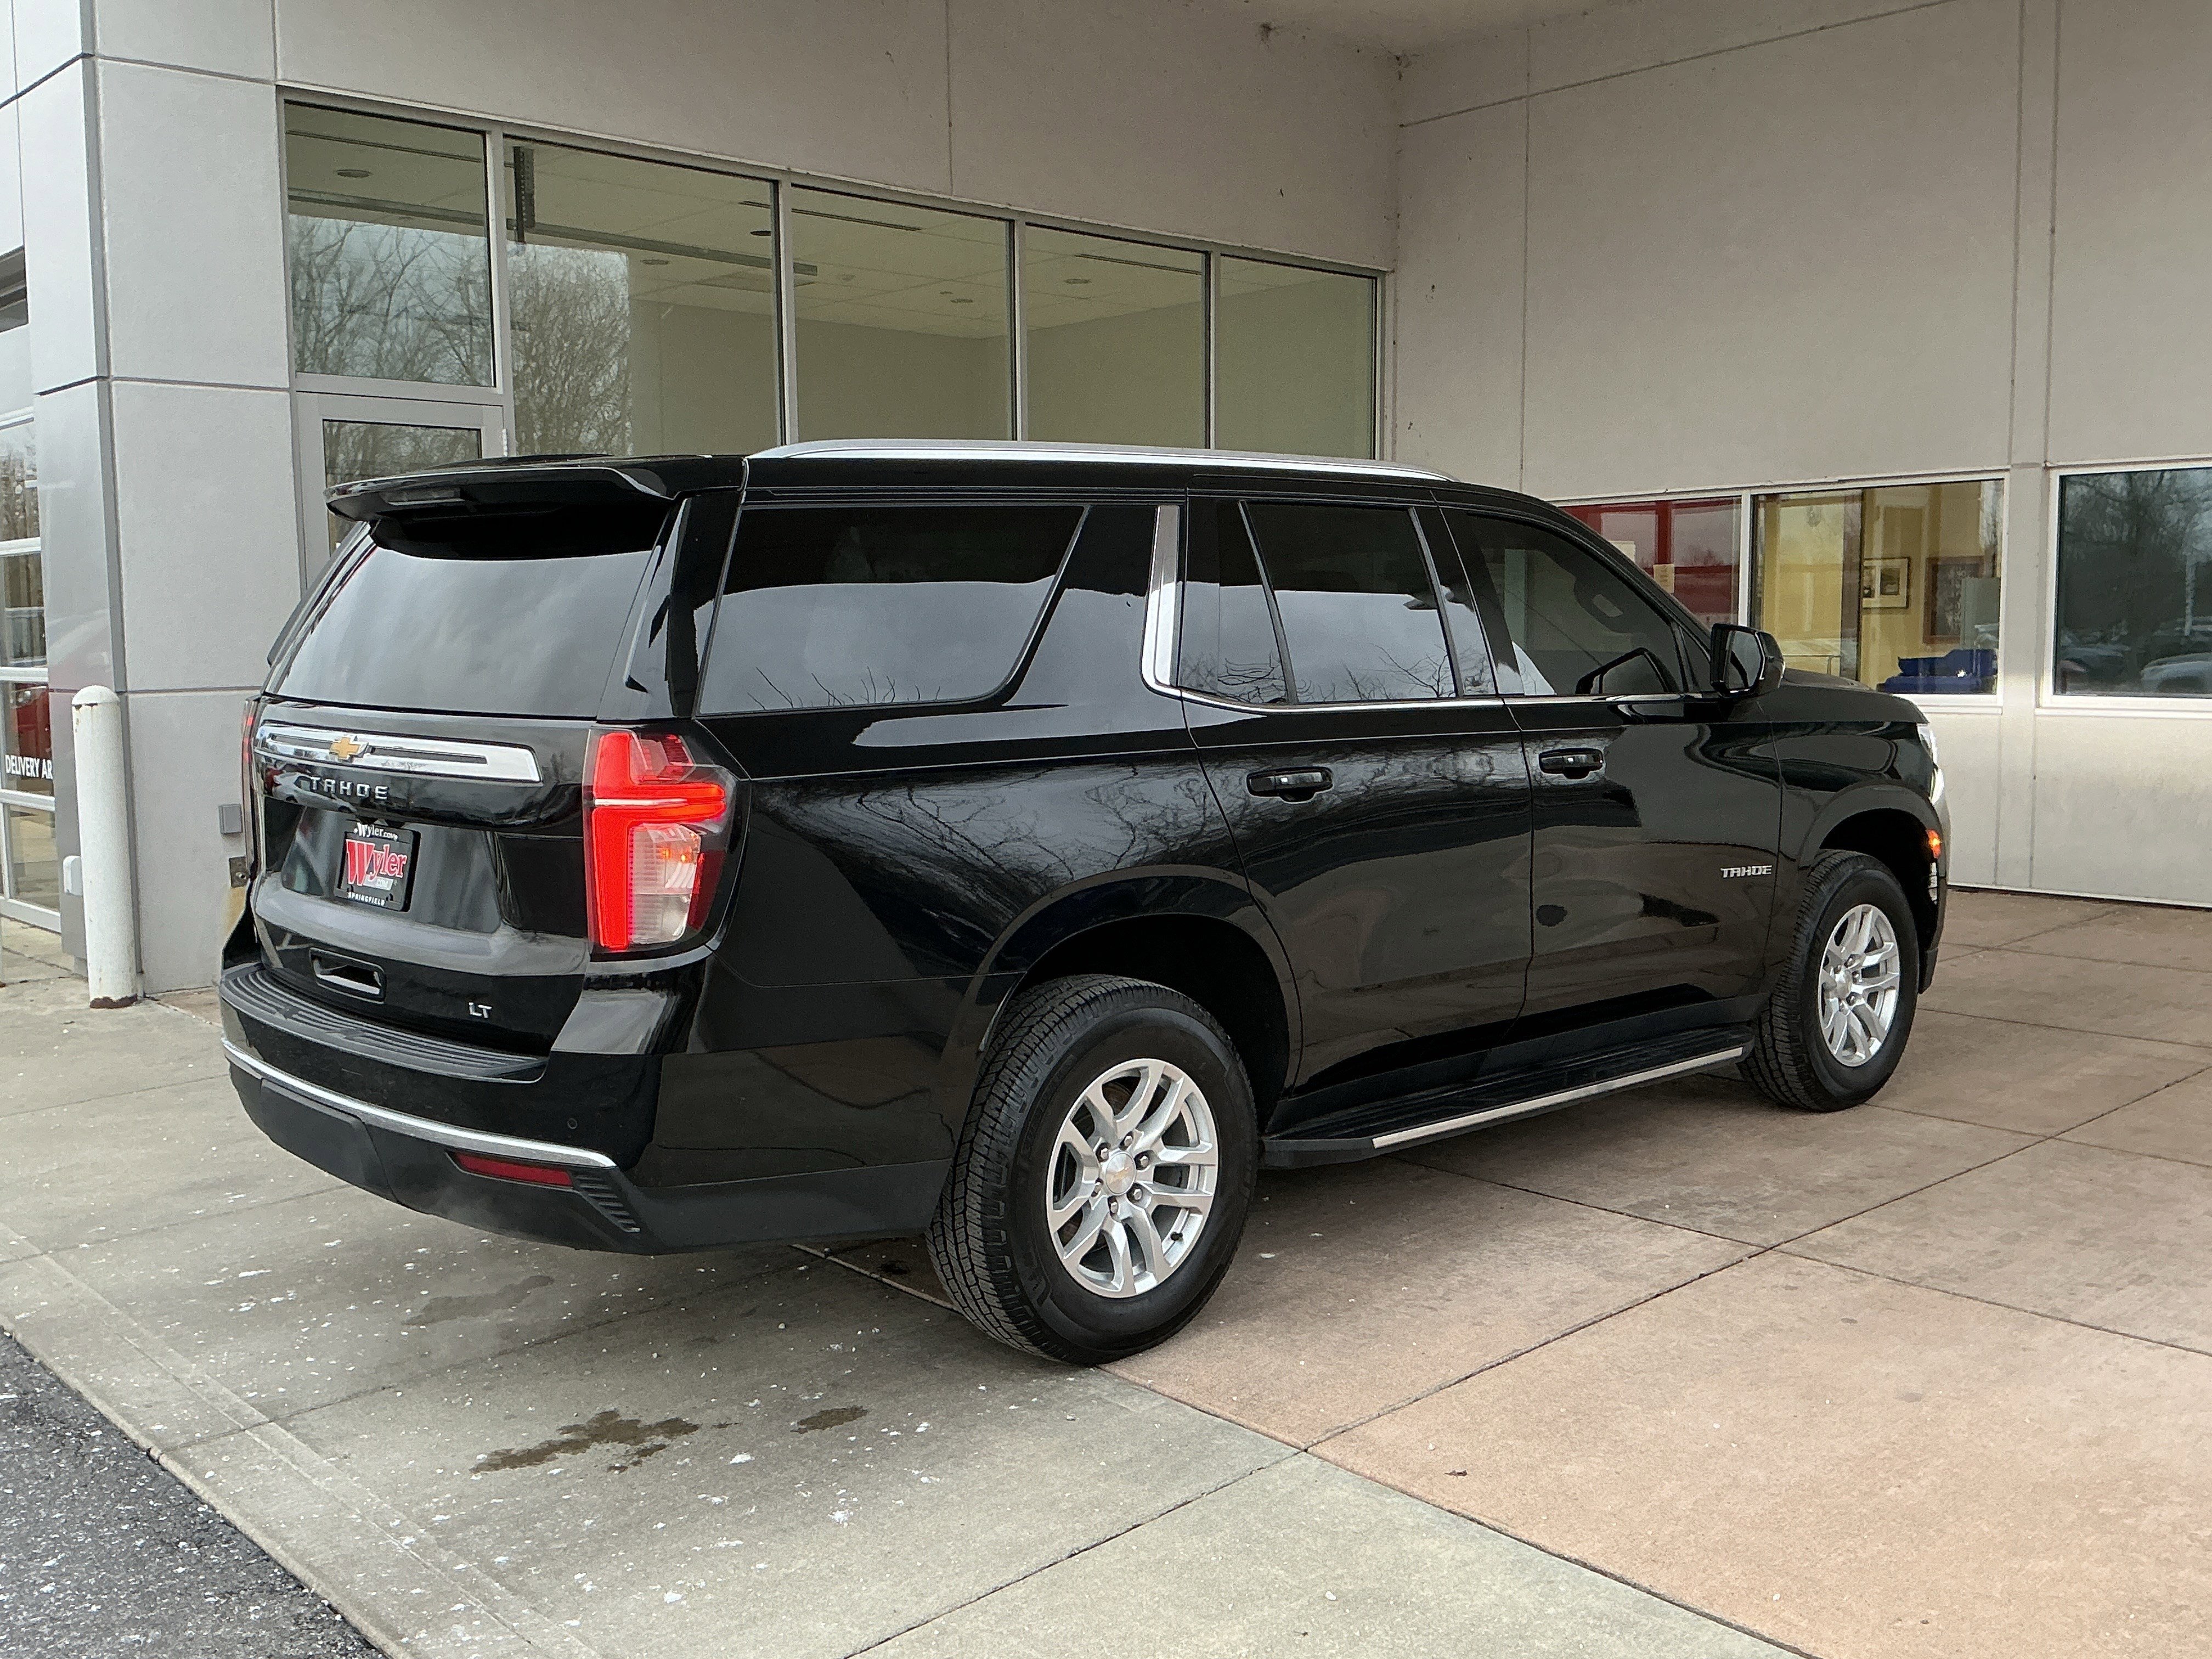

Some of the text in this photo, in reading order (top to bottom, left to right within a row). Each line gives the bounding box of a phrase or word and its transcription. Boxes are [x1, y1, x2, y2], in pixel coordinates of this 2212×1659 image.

[5, 754, 40, 777] DELIVERY
[311, 776, 388, 800] TAHOE
[346, 839, 408, 887] Wyler
[1720, 865, 1772, 878] TAHOE
[347, 891, 386, 906] SPRINGFIELD
[469, 1002, 492, 1018] LT
